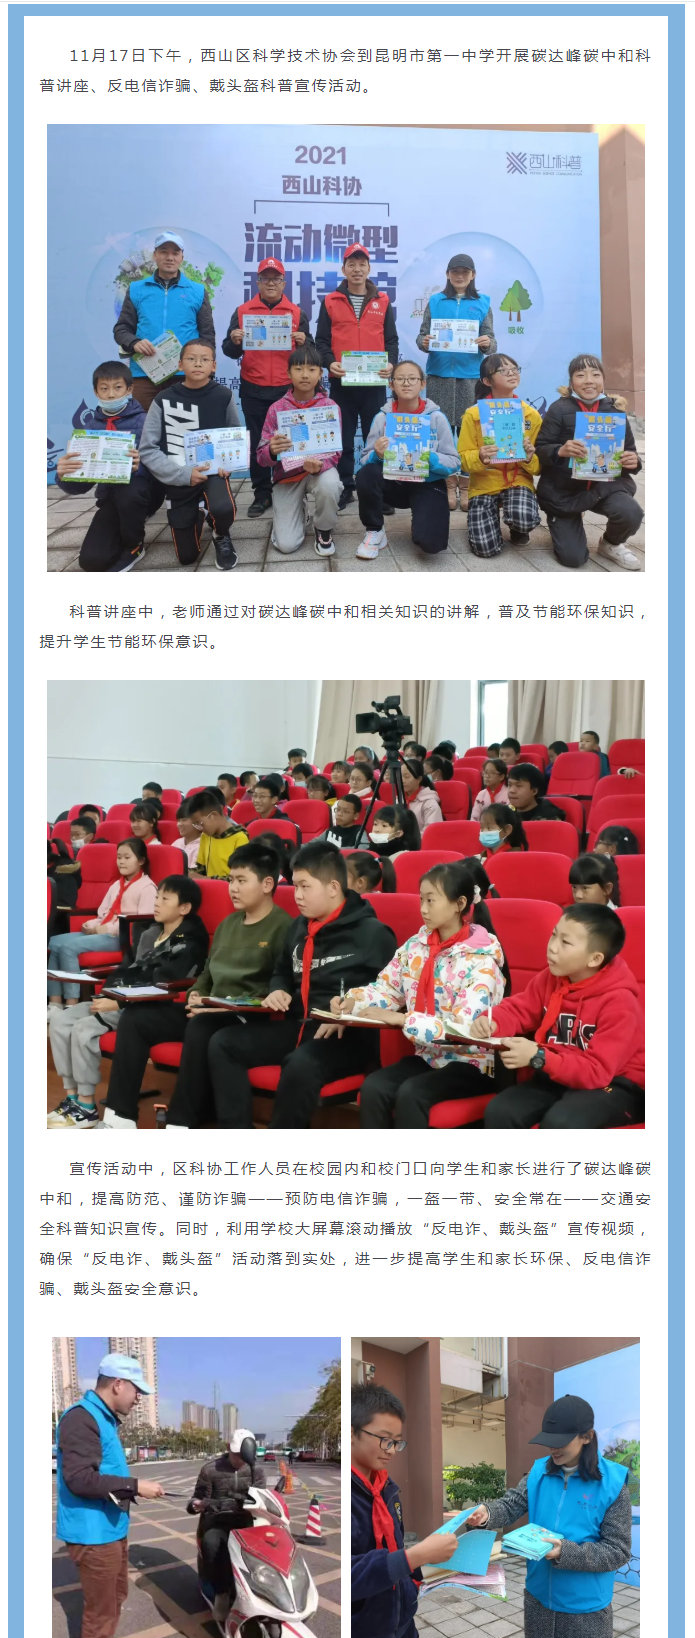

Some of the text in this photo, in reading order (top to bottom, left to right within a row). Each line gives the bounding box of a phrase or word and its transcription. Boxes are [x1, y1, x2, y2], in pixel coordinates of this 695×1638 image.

[295, 145, 347, 165] 2021
[281, 175, 362, 196] 西山科协
[244, 222, 399, 264] 流动微型
